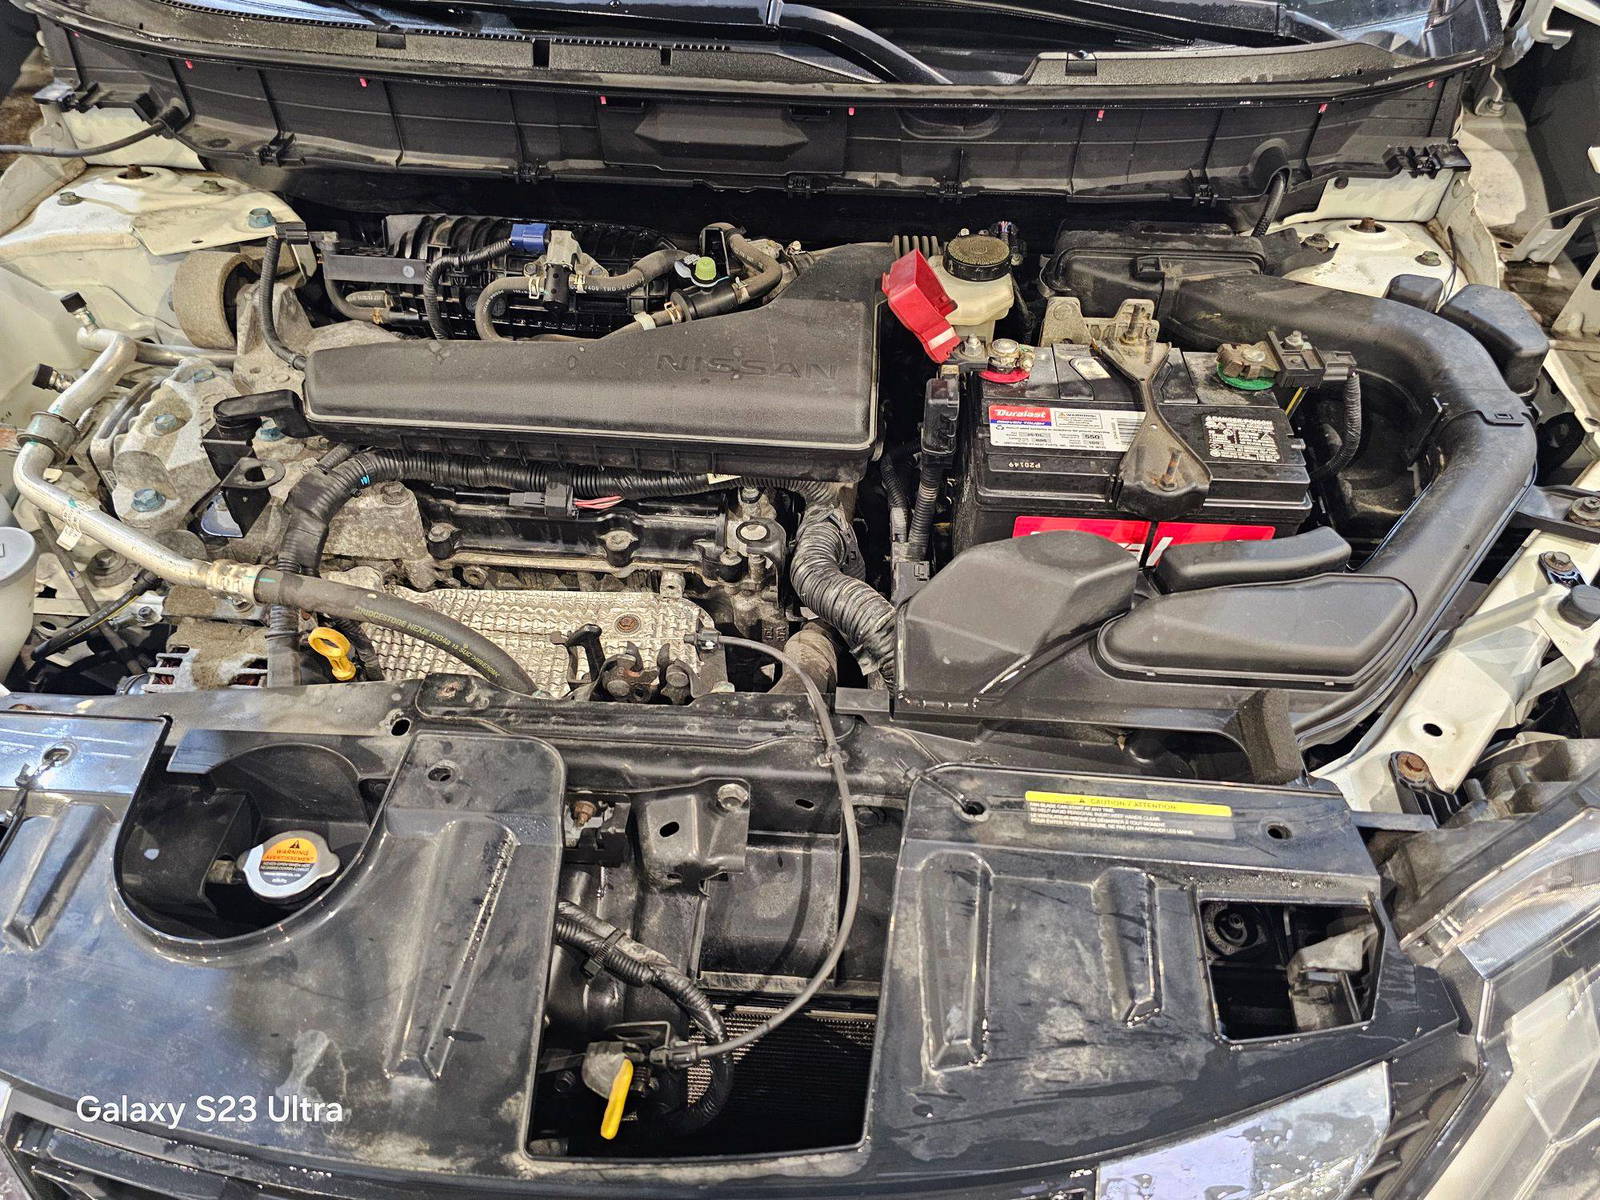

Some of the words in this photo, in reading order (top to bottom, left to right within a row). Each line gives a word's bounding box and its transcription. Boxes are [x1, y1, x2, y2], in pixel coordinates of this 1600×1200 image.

[657, 354, 837, 379] NISSAN
[994, 409, 1046, 419] Duralast
[1091, 799, 1126, 807] CAUTION
